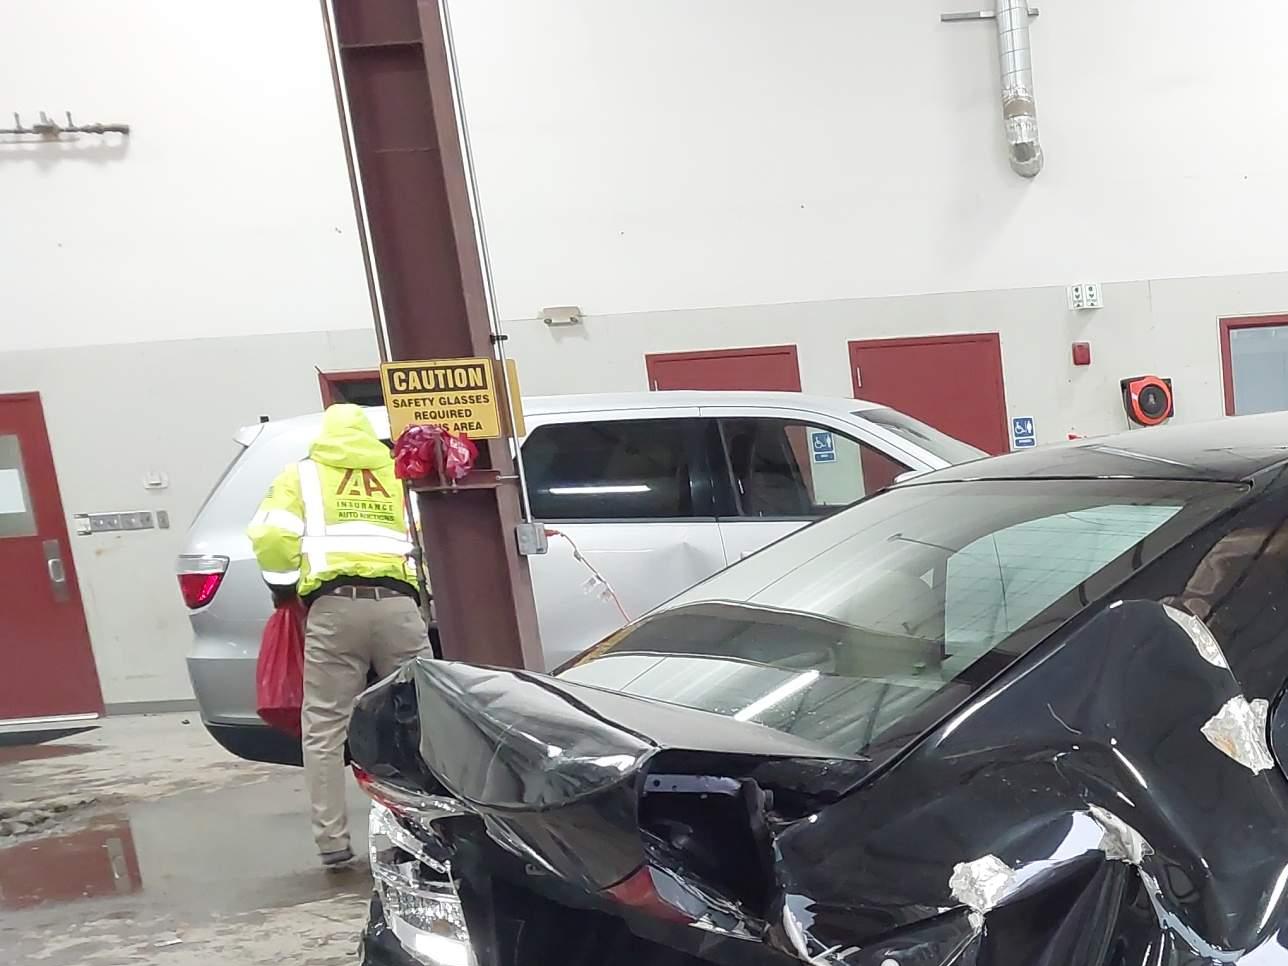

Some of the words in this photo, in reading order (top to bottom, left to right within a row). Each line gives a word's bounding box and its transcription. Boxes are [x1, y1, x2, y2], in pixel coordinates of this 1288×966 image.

[393, 367, 484, 391] CAUTION
[392, 397, 435, 408] SAFETY
[438, 394, 490, 406] GLASSES
[414, 408, 473, 420] REQUIRED
[453, 421, 483, 432] AREA
[336, 501, 393, 511] INSURANCE
[338, 511, 359, 519] AUTO
